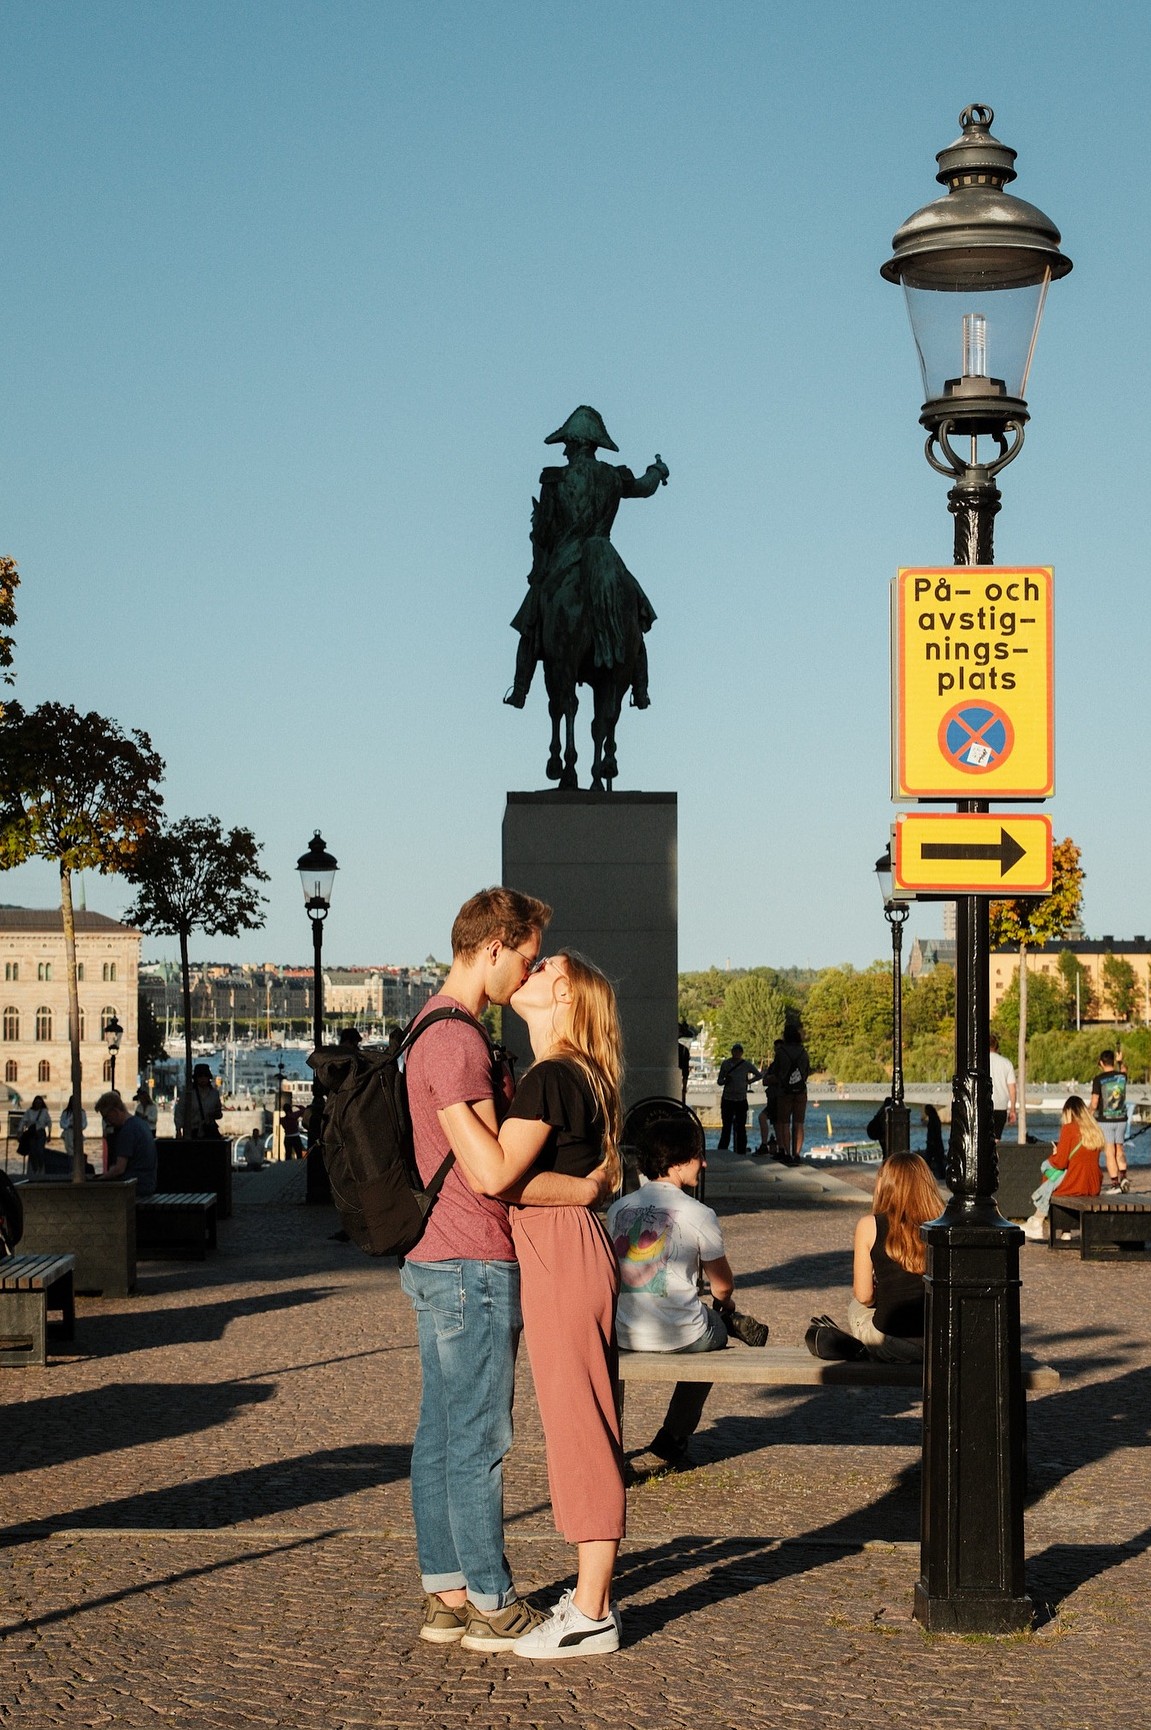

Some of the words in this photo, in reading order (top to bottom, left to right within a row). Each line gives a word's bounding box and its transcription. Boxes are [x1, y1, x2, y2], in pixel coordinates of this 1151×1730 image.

[914, 577, 971, 602] På-
[984, 577, 1039, 602] och
[918, 605, 1036, 636] avstig-
[925, 635, 1029, 666] nings-
[938, 666, 1016, 696] plats
